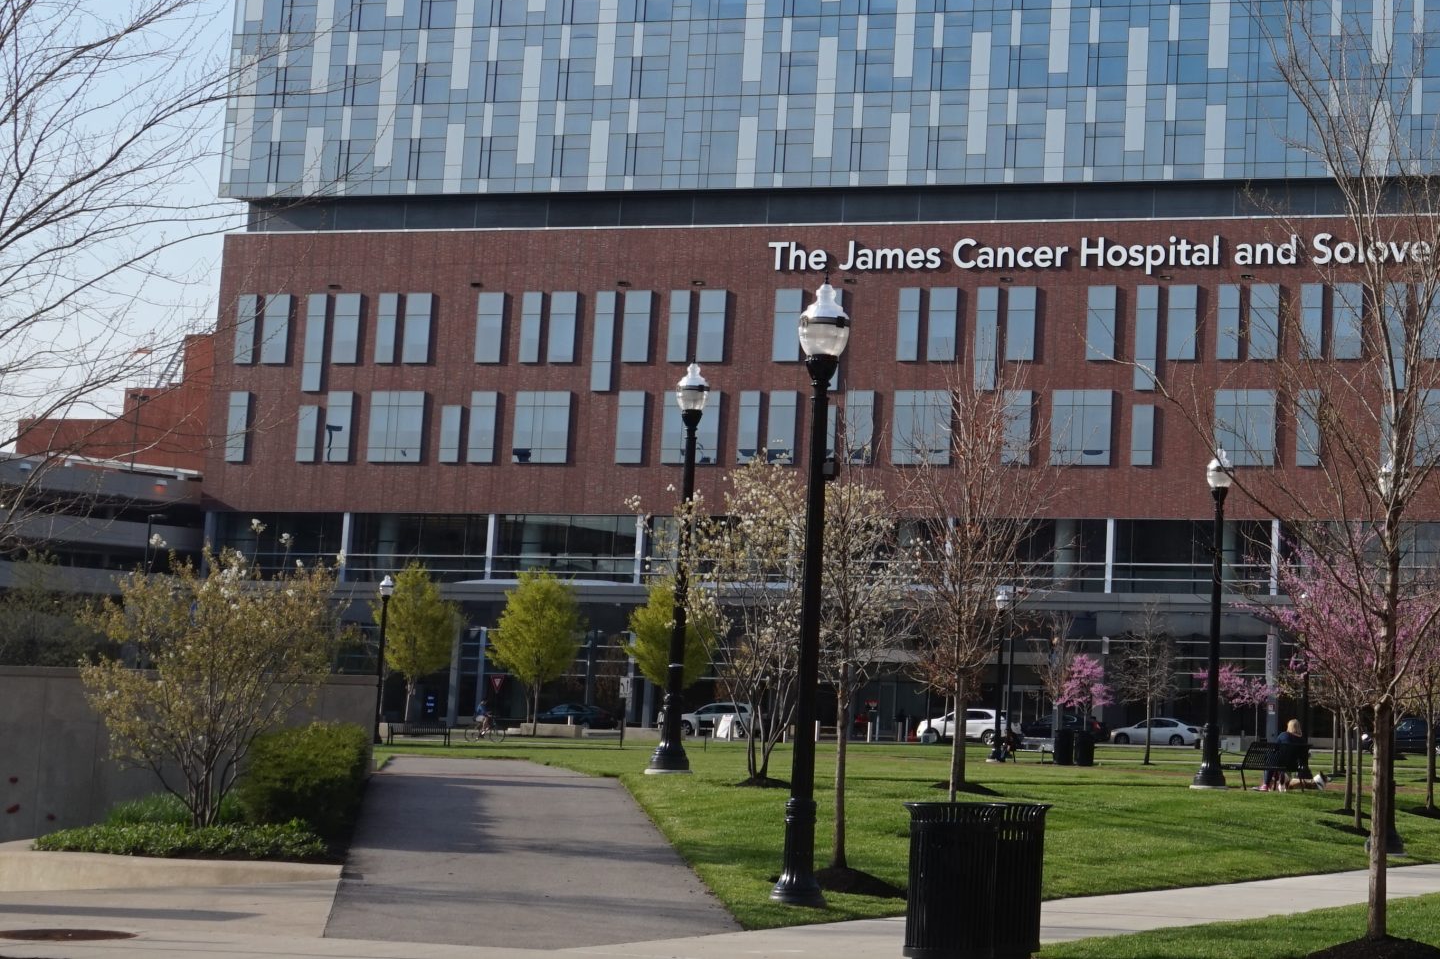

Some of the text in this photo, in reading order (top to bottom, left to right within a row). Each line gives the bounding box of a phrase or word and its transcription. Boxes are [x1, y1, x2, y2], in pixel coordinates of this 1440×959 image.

[768, 242, 828, 271] The
[839, 241, 941, 270] James
[953, 238, 1069, 269] Cancer
[1080, 235, 1219, 275] Hospital
[1235, 234, 1297, 265] and
[1313, 233, 1430, 264] Solove
